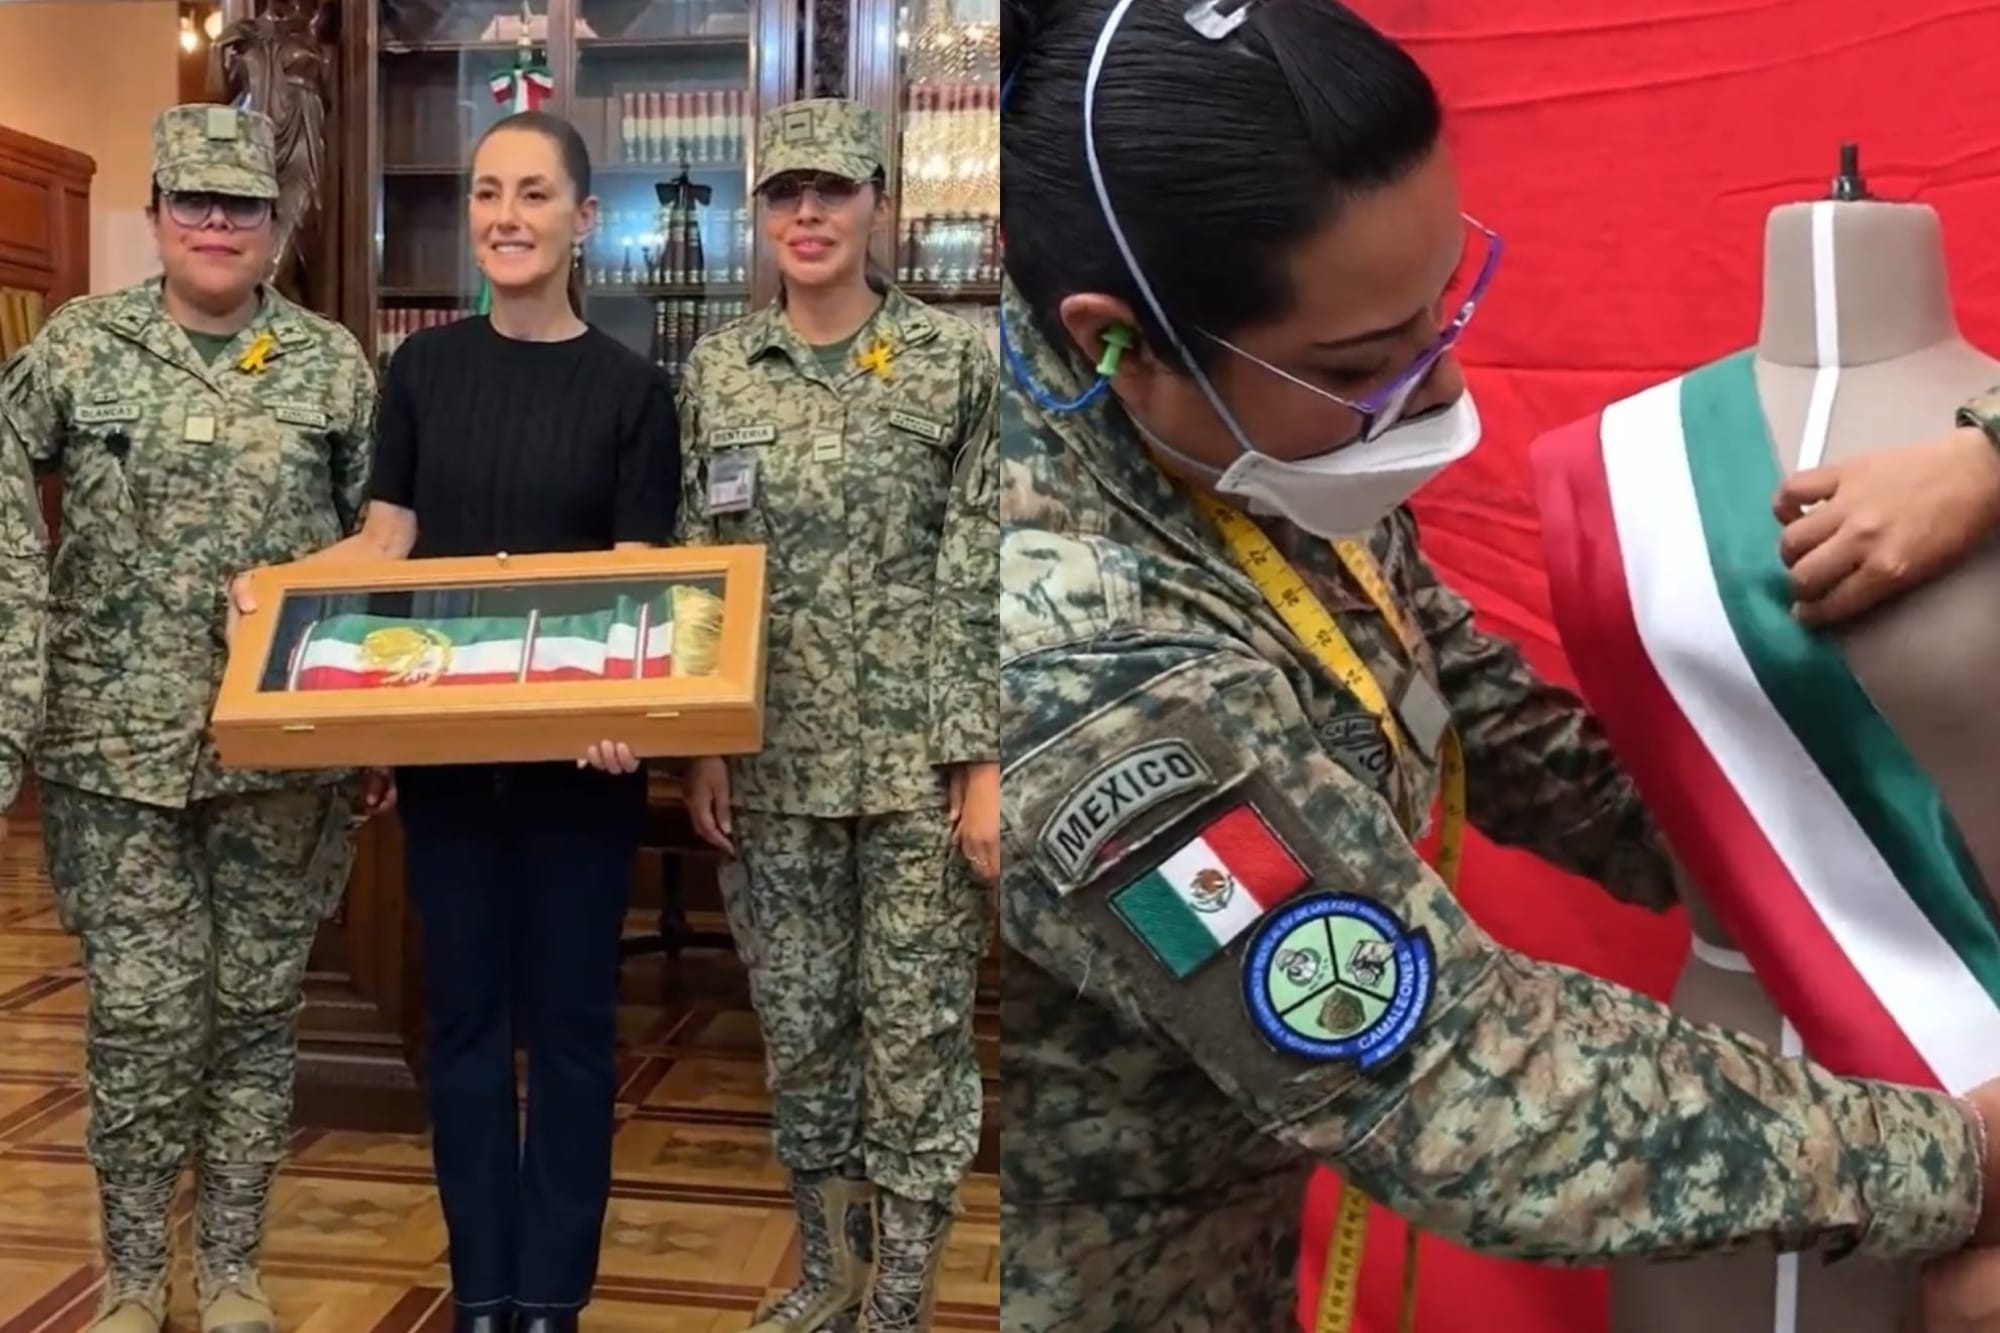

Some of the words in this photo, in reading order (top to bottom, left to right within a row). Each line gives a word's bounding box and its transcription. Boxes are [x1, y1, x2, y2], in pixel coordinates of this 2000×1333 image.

[1249, 549, 1269, 567] 27
[1315, 628, 1334, 648] 25
[1056, 752, 1197, 864] MEXICO
[1358, 949, 1415, 1050] CAMALEONES
